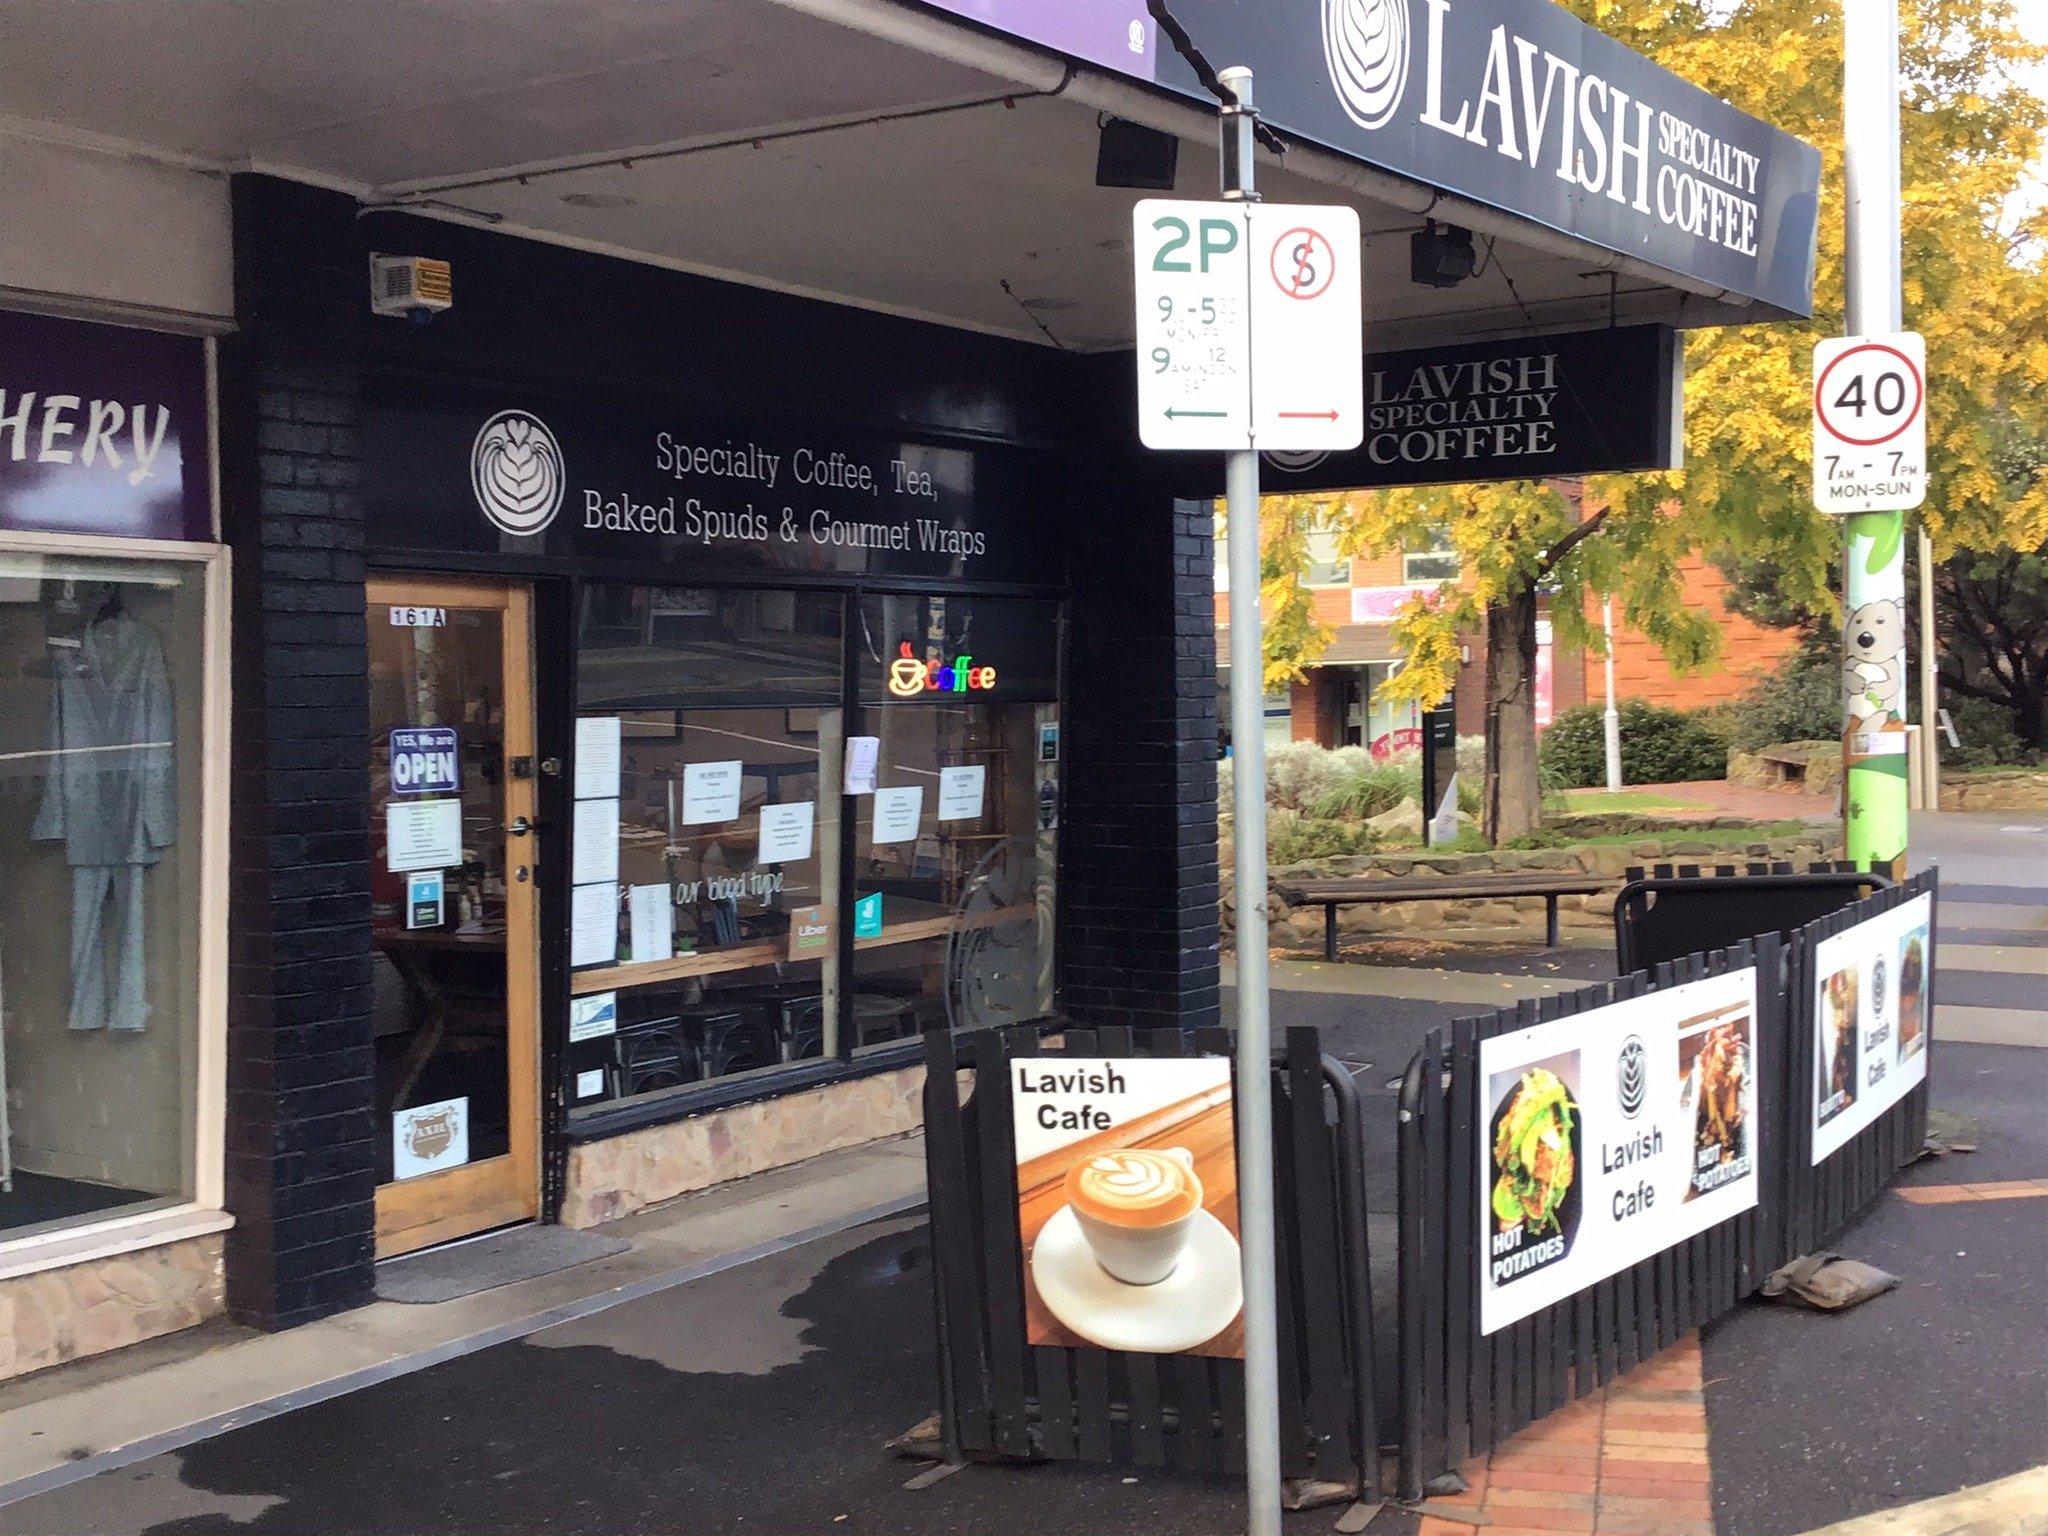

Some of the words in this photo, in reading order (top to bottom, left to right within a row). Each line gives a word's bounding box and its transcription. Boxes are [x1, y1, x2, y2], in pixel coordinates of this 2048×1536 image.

[1420, 0, 1653, 214] LAVISH
[1658, 111, 1760, 194] SPECIALTY
[1657, 165, 1758, 257] COFFEE
[1152, 216, 1239, 273] 2P
[1370, 354, 1559, 404] LAVISH
[1834, 372, 1905, 417] 40
[1370, 392, 1558, 430] SPECIALTY
[1368, 421, 1558, 465] COFFEE
[656, 432, 780, 488] Specialty
[793, 448, 878, 496] Coffee,
[890, 459, 938, 502] Tea,
[1829, 482, 1912, 498] MON-SUN
[583, 489, 676, 535] Baked
[685, 498, 768, 545] Spuds
[779, 507, 799, 543] &
[810, 509, 911, 551] Gourmet
[916, 518, 986, 561] Wraps
[394, 608, 445, 627] 161A
[925, 656, 996, 692] Coffee
[395, 752, 454, 785] OPEN
[1020, 1067, 1125, 1093] Lavish
[1038, 1104, 1111, 1130] Cafe
[1603, 1124, 1662, 1174] Lavish
[1612, 1179, 1655, 1222] Cafe
[1493, 1224, 1524, 1256] HOT
[1493, 1233, 1564, 1283] POTATOES
